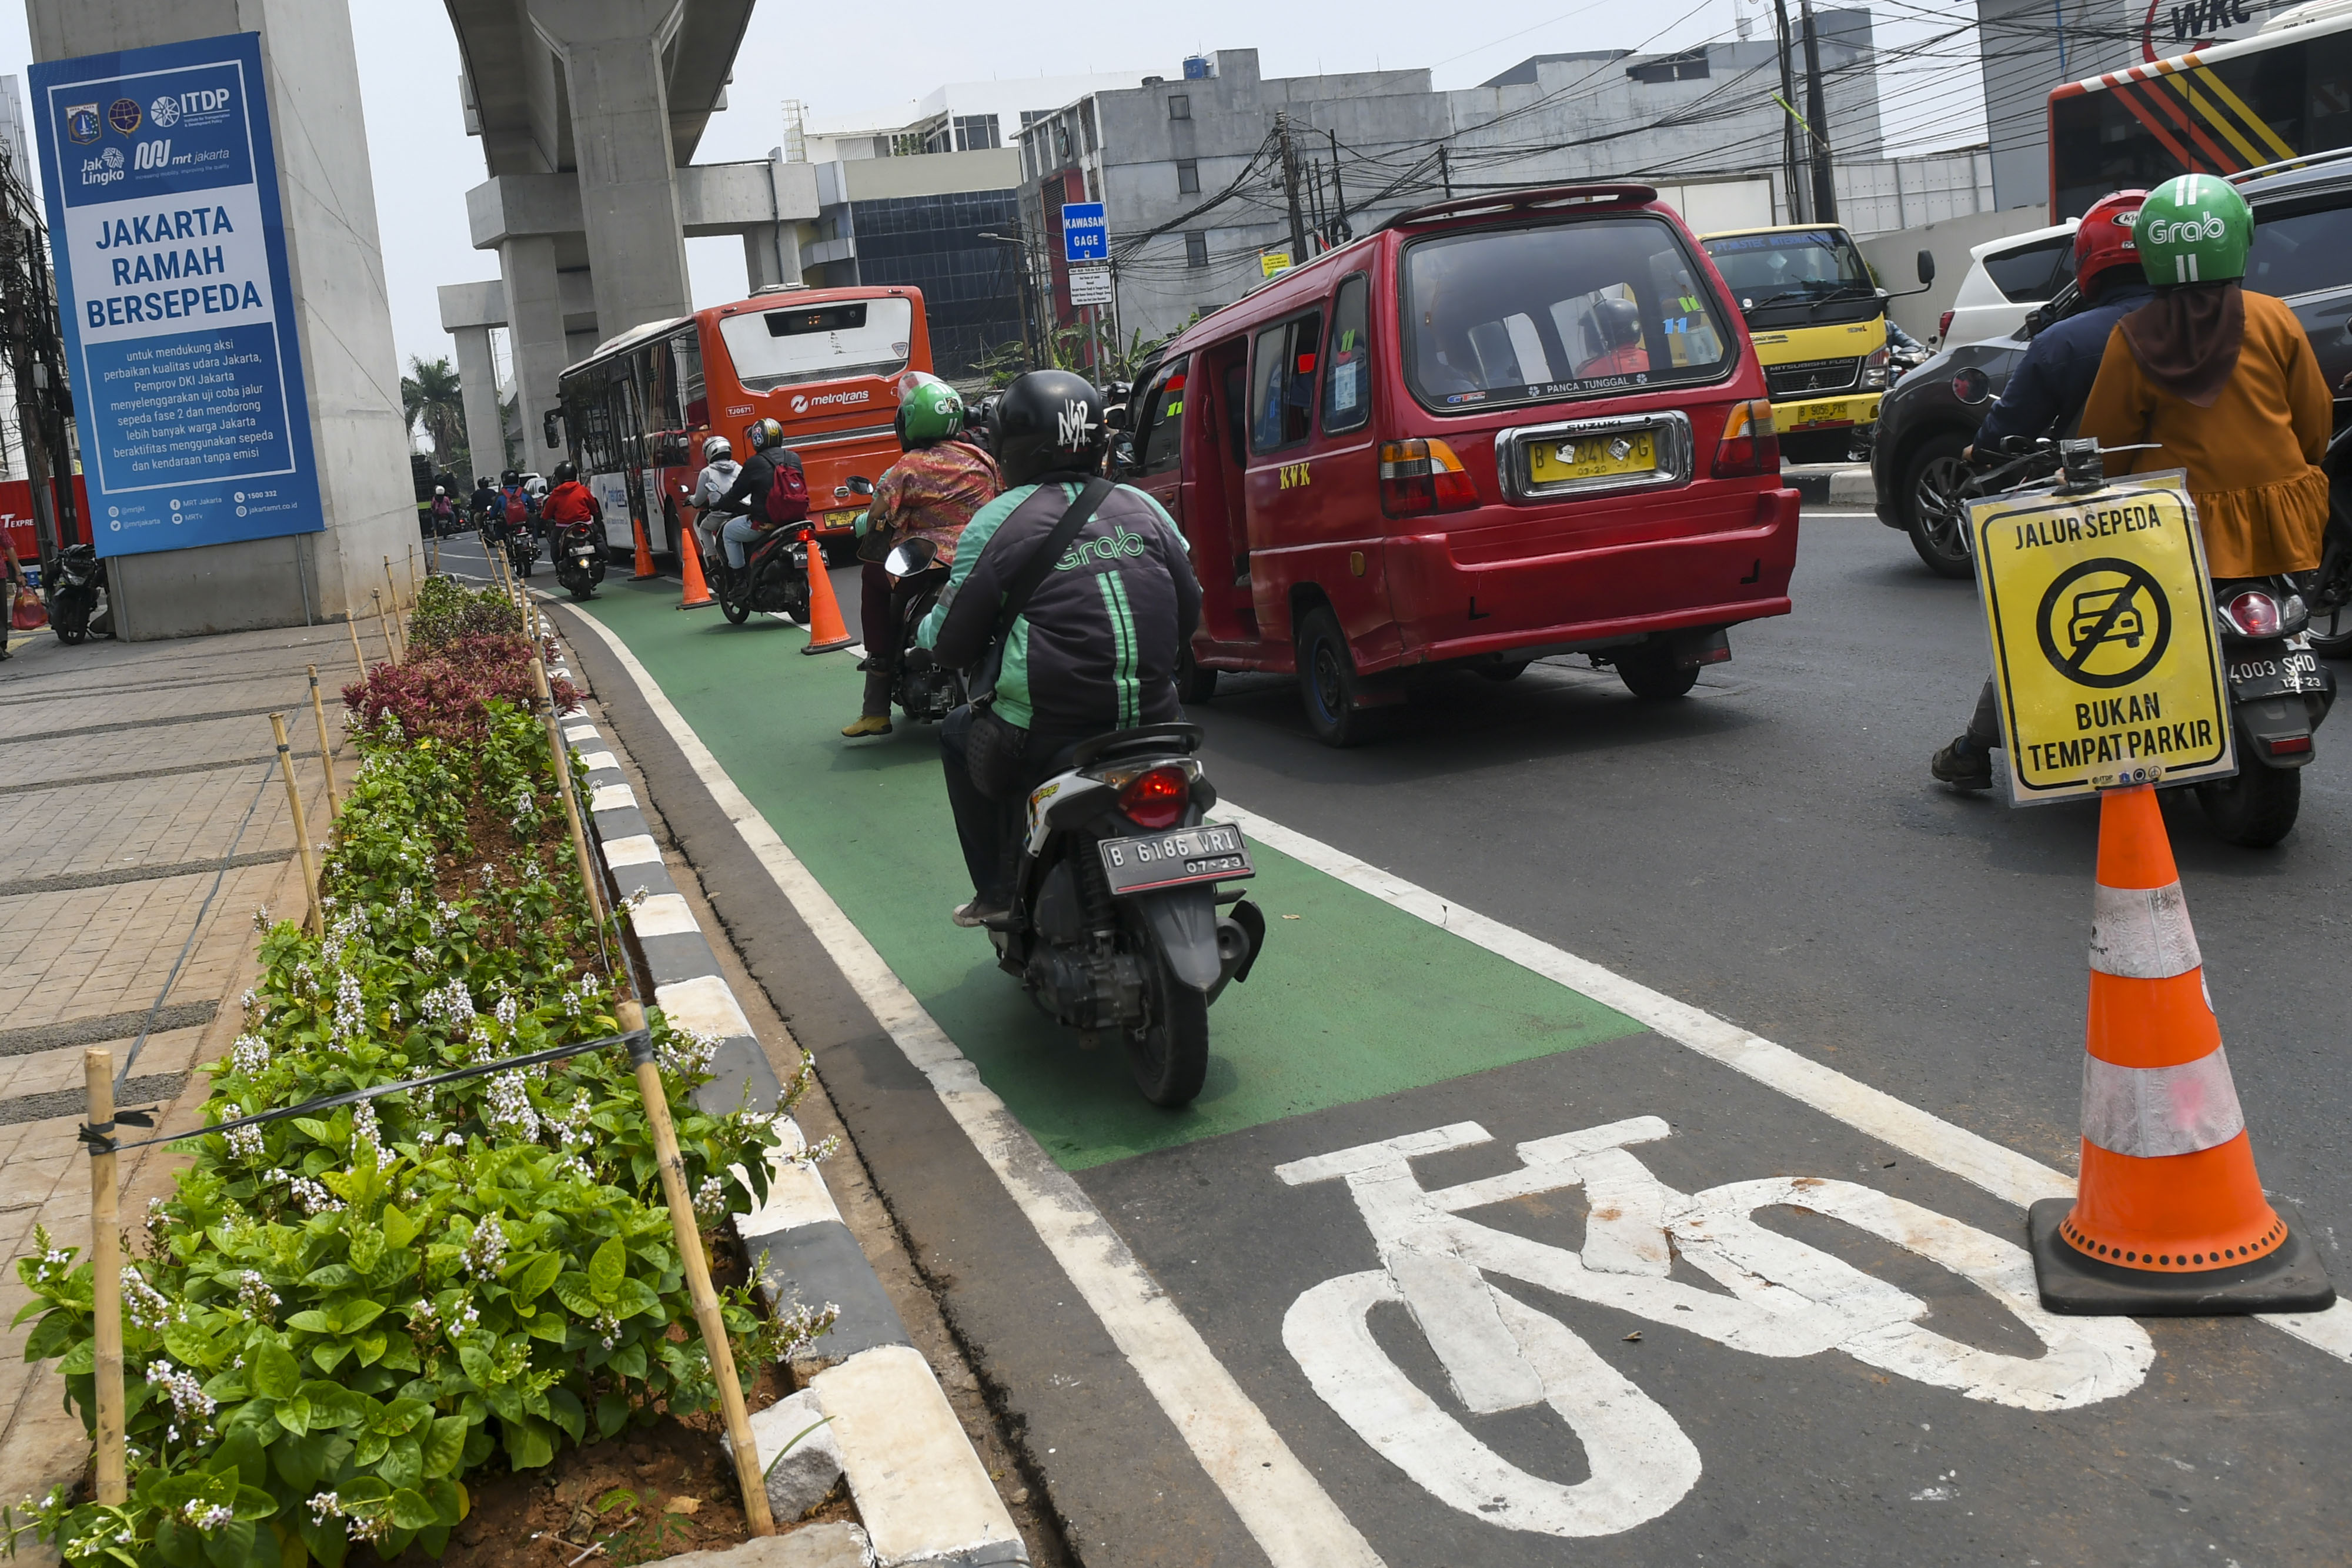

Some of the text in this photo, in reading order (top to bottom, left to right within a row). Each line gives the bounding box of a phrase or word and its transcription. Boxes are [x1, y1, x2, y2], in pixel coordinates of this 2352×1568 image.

[181, 88, 229, 113] ITDP
[81, 158, 102, 172] Jak
[172, 149, 229, 165] mrt jakarta
[82, 169, 125, 186] Lingko
[96, 206, 233, 249] JAKARTA
[1065, 216, 1104, 229] KAWASAN
[2148, 210, 2224, 245] Grab
[1074, 235, 1098, 246] GAGE
[112, 245, 225, 286] RAMAH
[86, 280, 263, 328] BERSEPEDA
[126, 339, 233, 362] untuk mendukung aksi
[104, 353, 262, 382] perbaikan kualitas udara Jakarta,
[1770, 361, 1826, 372] MITSUBISHI
[134, 372, 235, 392] Pemprov DKI Jakarta
[1546, 377, 1630, 394] PANCA TUNGGAL
[111, 384, 263, 411] menyelenggarakan uji coba jalur
[811, 390, 870, 406] metrotrans
[118, 400, 261, 427] sepeda fase 2 dan mendorong
[126, 416, 256, 440] lebih banyak warga Jakarta
[1567, 420, 1622, 432] SUZUKI
[113, 430, 274, 458] beraktifitas menggunakan sepeda
[132, 447, 259, 472] dan kendaraan tanpa emisi
[1535, 446, 1544, 469] B
[1279, 462, 1310, 490] KWK
[199, 497, 222, 506] Jakarta
[249, 502, 298, 514] jakartamrt.co.id
[11, 519, 35, 528] EXPRE
[2015, 504, 2161, 550] JALUR SEPEDA
[1054, 526, 1144, 570] Grab
[2229, 660, 2276, 679] 4003
[2075, 691, 2160, 731] BUKAN
[2028, 719, 2213, 771] TEMPAT PARKIR
[1110, 831, 1235, 867] B 6186 VRI
